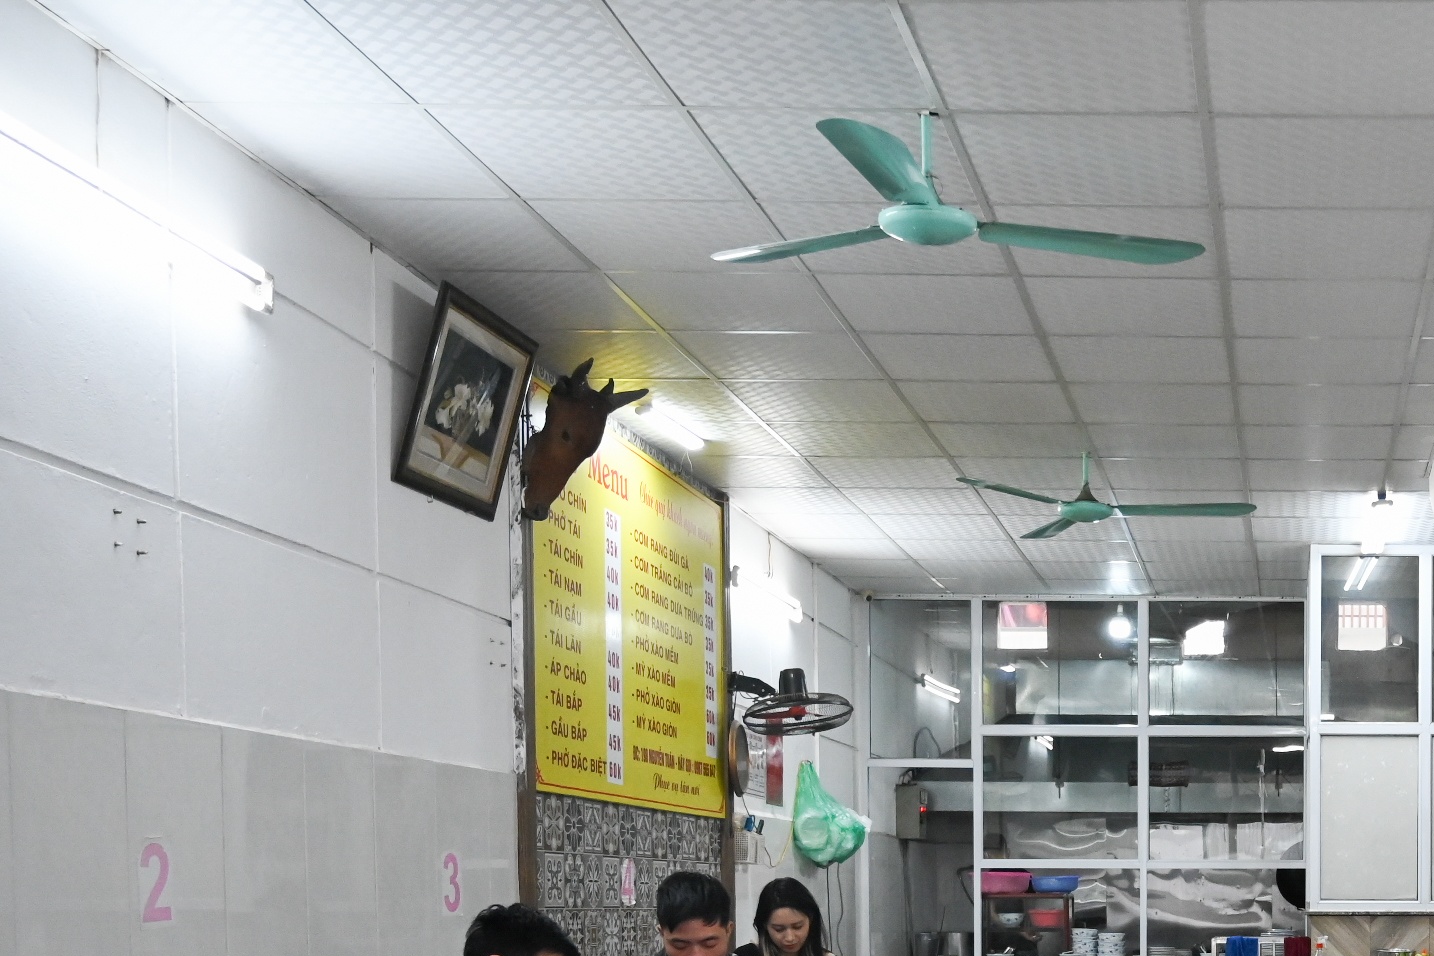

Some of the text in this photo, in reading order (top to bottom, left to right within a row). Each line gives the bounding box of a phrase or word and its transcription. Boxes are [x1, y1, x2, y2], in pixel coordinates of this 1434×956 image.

[588, 452, 628, 501] Menu
[567, 490, 587, 514] CHÍN
[568, 519, 581, 539] TÁI
[548, 538, 584, 569] TÁI CHÍN
[633, 529, 649, 549] CƠM
[650, 538, 668, 559] RANG
[634, 555, 649, 574] CƠM
[548, 568, 582, 597] TÁI NẠM
[549, 598, 563, 619] TÁI
[634, 582, 650, 601] CƠM
[651, 590, 669, 610] RANG
[635, 609, 650, 627] CƠM
[651, 616, 669, 635] RANG
[549, 628, 563, 649] TÁI
[635, 634, 650, 653] PHỞ
[650, 640, 664, 659] XÀO
[550, 656, 587, 685] ÁP CHẢO
[647, 663, 661, 683] XÀO
[550, 688, 583, 711] TÁI BẮP
[636, 686, 650, 705] PHỞ
[651, 692, 665, 710] XÀO
[571, 720, 587, 742] BẮP
[647, 716, 661, 735] XÀO
[551, 747, 607, 777] PHỞ ĐẶC BIỆT
[140, 843, 172, 922] 2
[443, 852, 461, 913] 3
